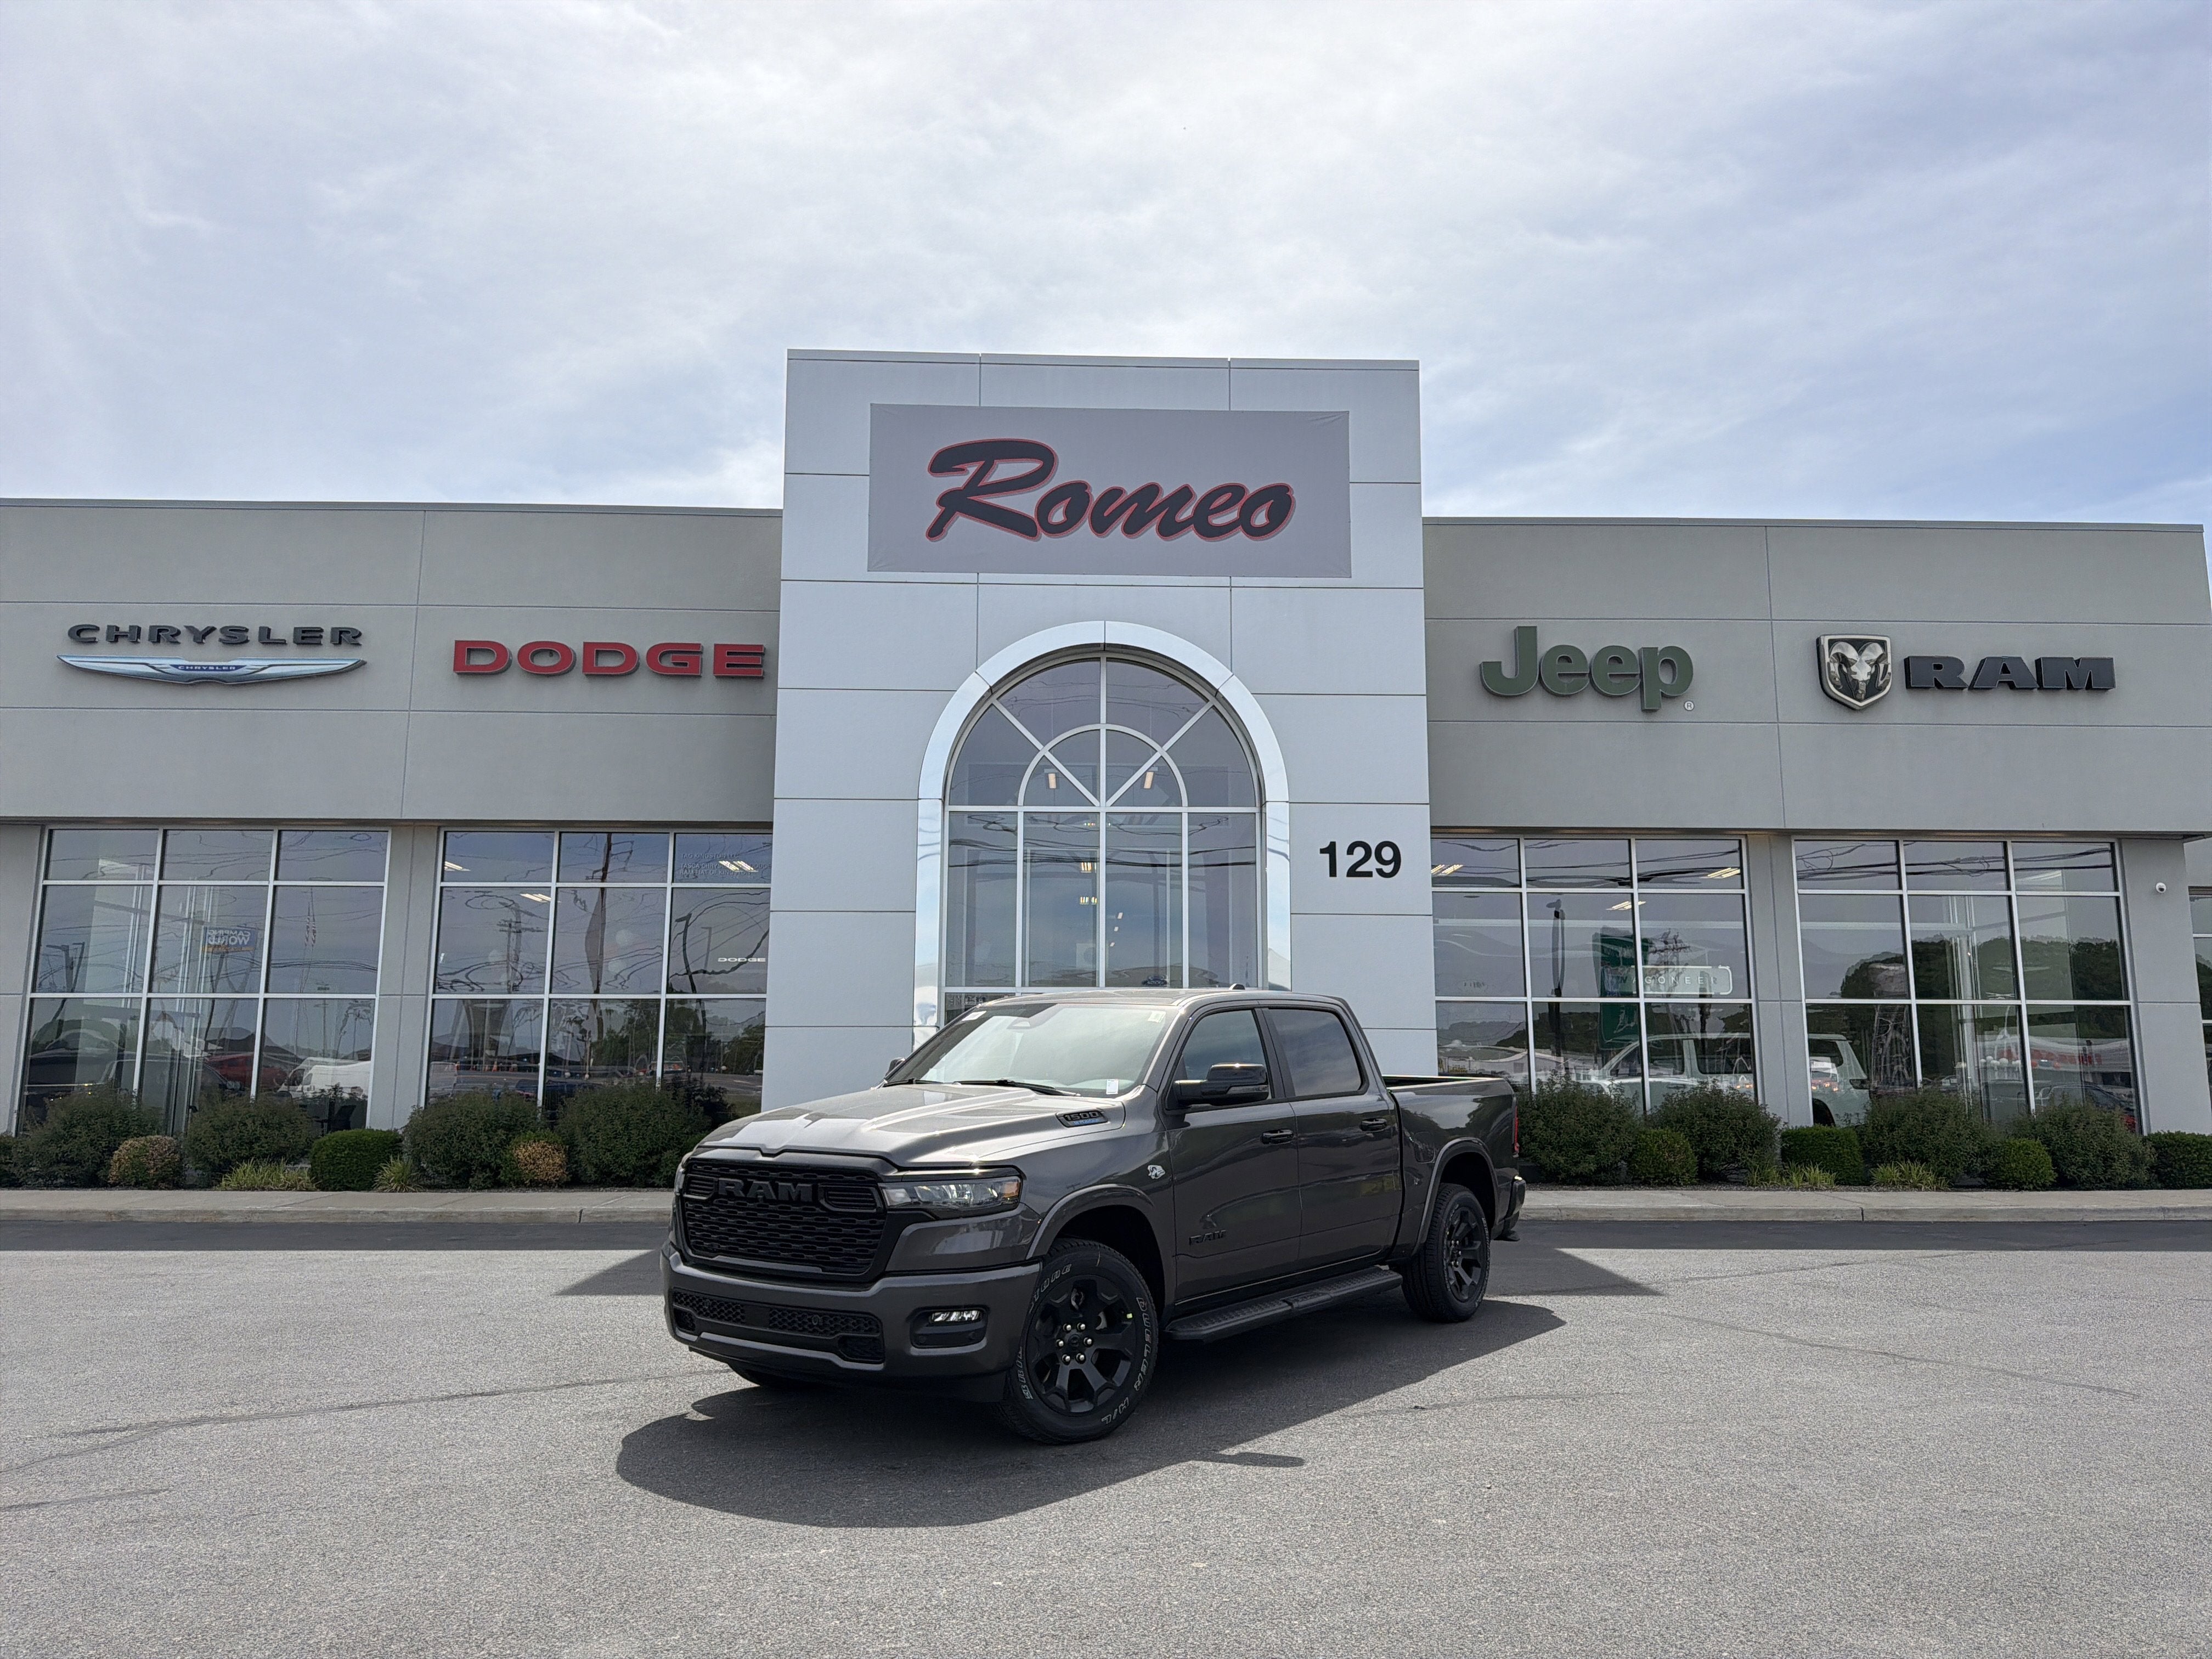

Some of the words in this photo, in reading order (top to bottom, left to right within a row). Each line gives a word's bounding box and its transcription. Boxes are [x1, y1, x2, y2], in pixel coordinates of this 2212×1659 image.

[926, 438, 1295, 542] Romeo
[67, 623, 363, 646] CHRYSLER
[453, 640, 766, 678] DODGE
[1480, 626, 1694, 712] Jeep
[1903, 656, 2116, 690] RAM
[1319, 840, 1401, 878] 129
[1065, 1111, 1099, 1121] 1500
[719, 1178, 812, 1202] RAM
[1189, 1229, 1226, 1246] RAM
